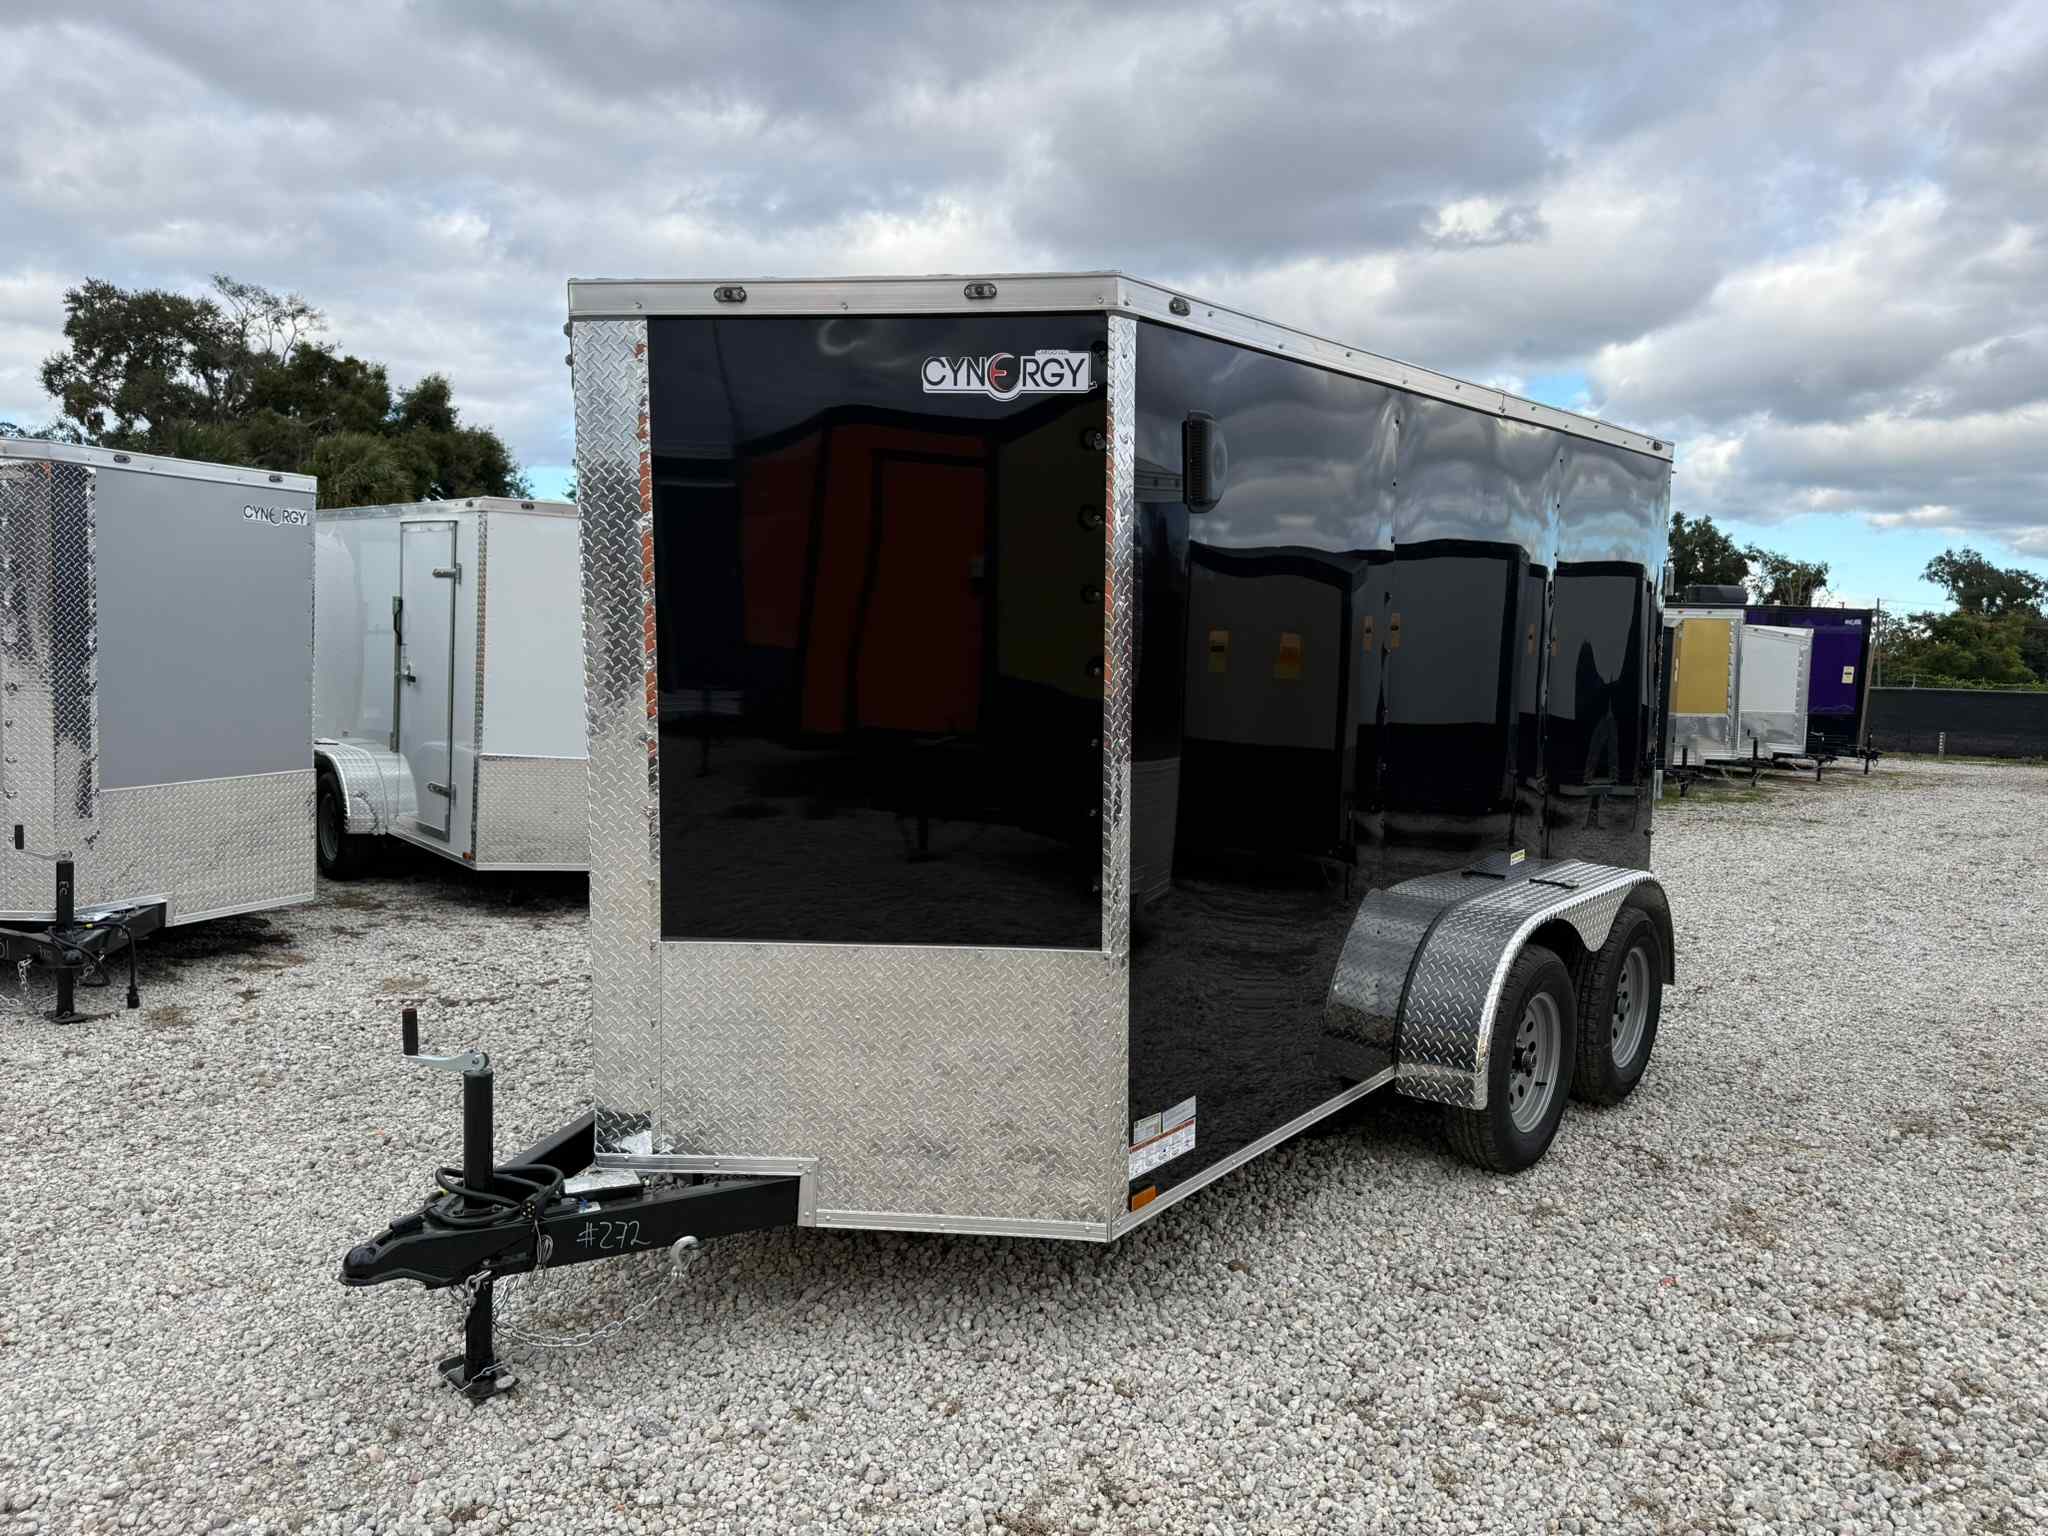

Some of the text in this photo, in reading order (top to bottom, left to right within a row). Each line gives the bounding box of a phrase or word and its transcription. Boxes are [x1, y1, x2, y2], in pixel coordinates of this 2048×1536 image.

[923, 352, 1086, 392] CYNERGY
[243, 505, 306, 524] CYNERGY
[576, 1220, 651, 1249] #272
